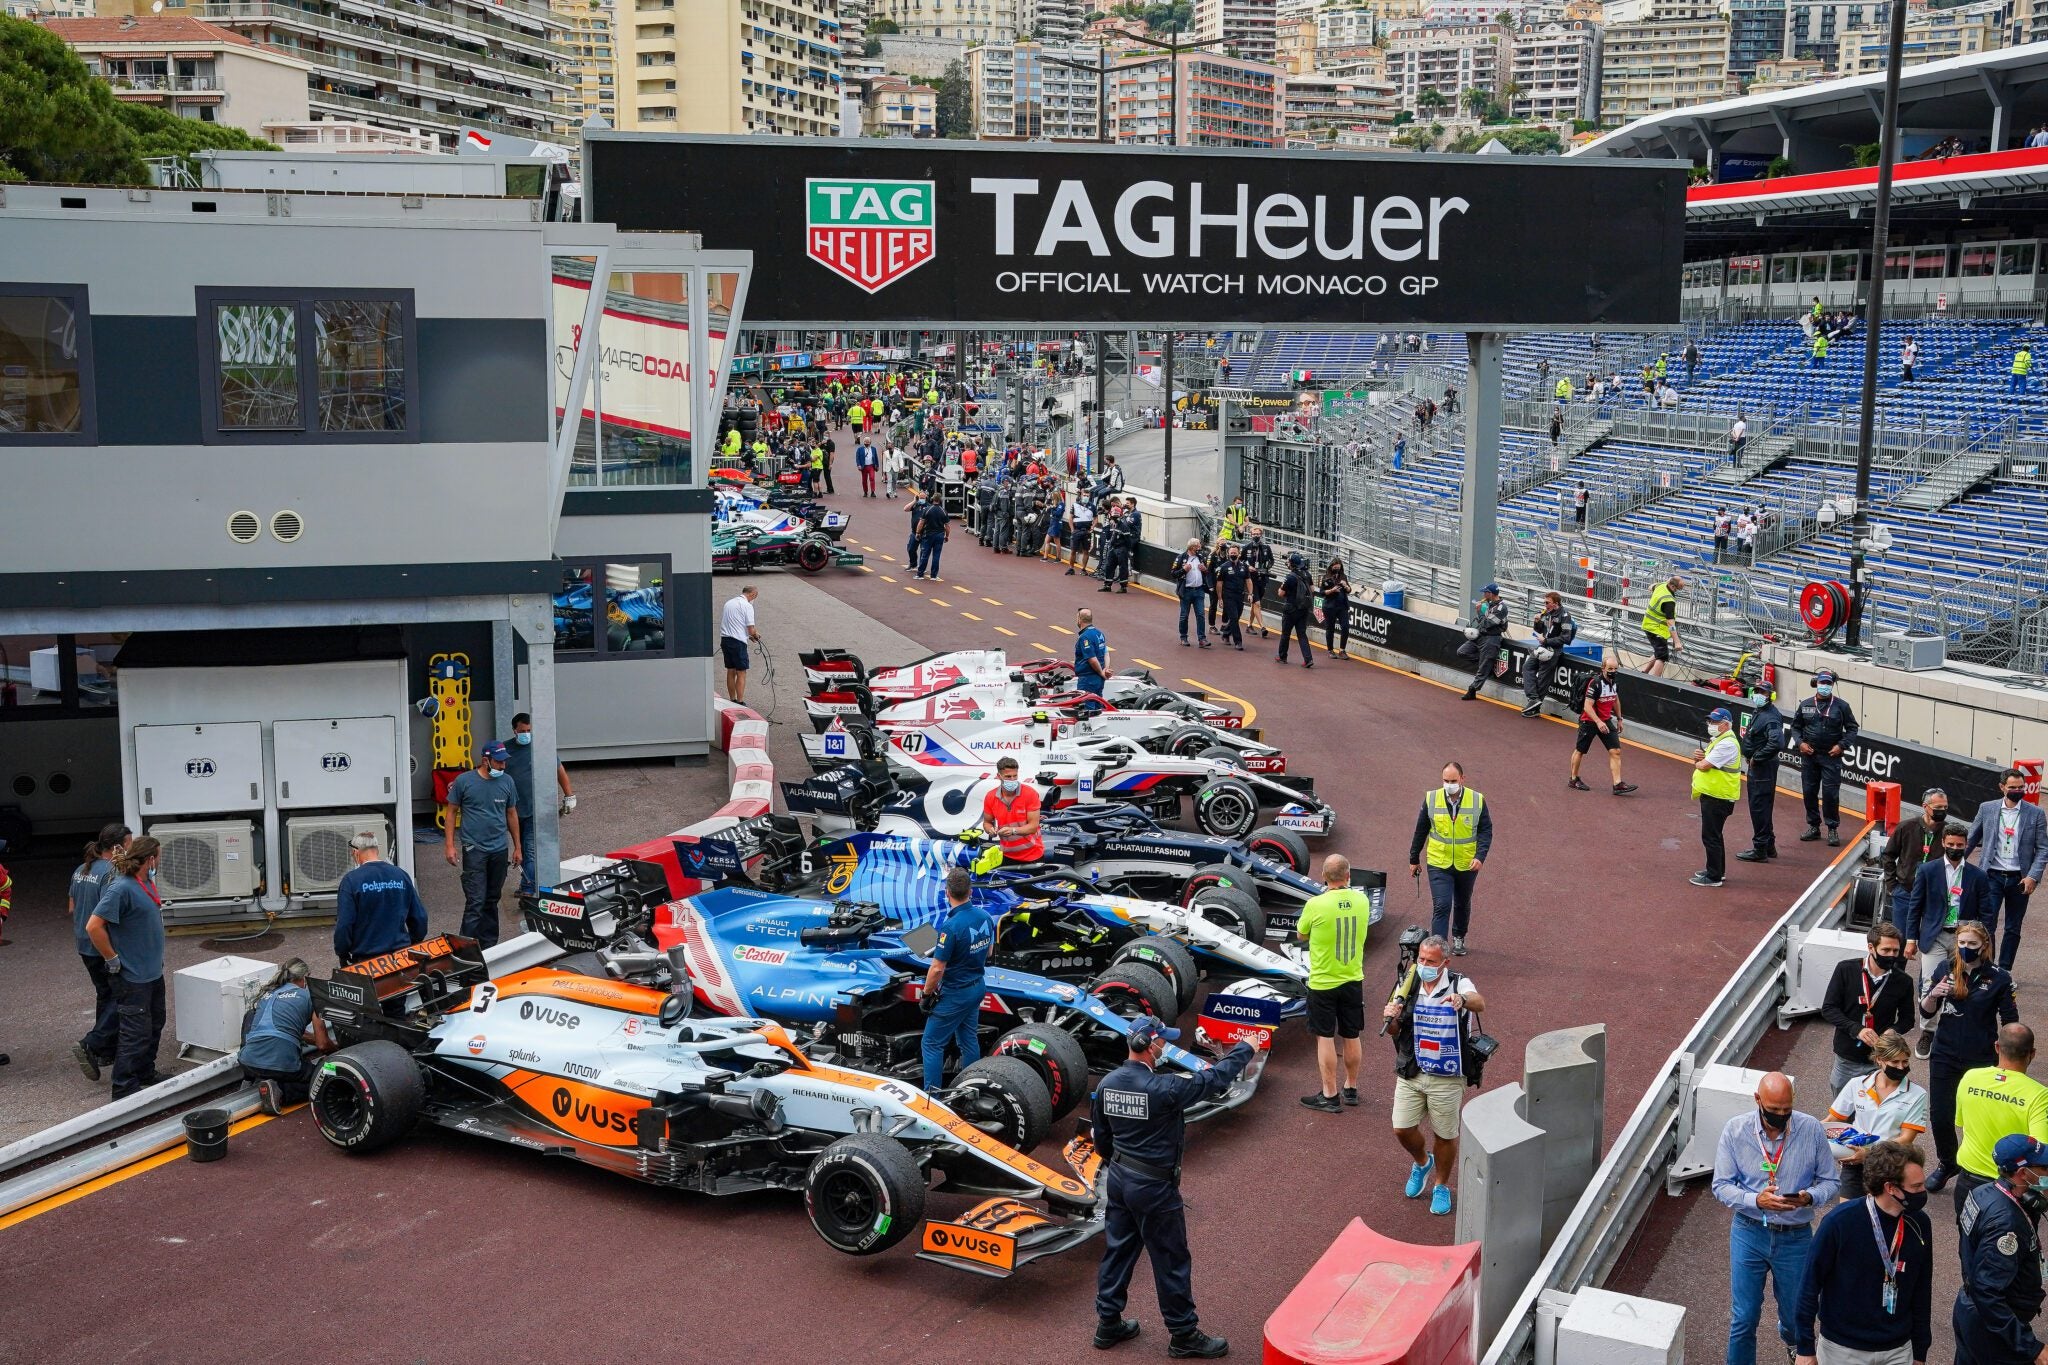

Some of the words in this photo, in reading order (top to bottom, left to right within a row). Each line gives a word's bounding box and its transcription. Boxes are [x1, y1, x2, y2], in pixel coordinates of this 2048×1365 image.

[816, 185, 925, 223] TAG
[813, 228, 929, 285] HEUER
[995, 271, 1131, 294] OFFICIAL
[1142, 272, 1245, 295] WATCH
[1257, 274, 1388, 296] MONACO
[1399, 275, 1440, 297] GP
[790, 516, 797, 526] 9
[712, 547, 732, 555] zant
[826, 737, 844, 750] 1&1
[902, 733, 923, 752] 47
[970, 741, 1021, 750] URALKALI
[1246, 760, 1265, 768] RLEN
[1778, 751, 1802, 765] OFFICI
[789, 787, 838, 801] ALPHATAURI
[896, 790, 916, 808] 22
[1277, 816, 1324, 830] URALKALI
[708, 855, 736, 865] VERSA
[800, 851, 813, 874] 6
[548, 901, 583, 917] Castrol
[667, 901, 692, 928] 14
[755, 917, 790, 927] RENAULT
[746, 924, 798, 938] E-TECH
[745, 947, 786, 964] Castrol
[331, 985, 361, 1002] Hilton
[473, 985, 497, 1013] 3
[751, 985, 846, 1010] ALPINE
[1213, 1001, 1261, 1019] Acronis
[1047, 1059, 1062, 1107] ZERO
[792, 1088, 830, 1100] RICHARD
[831, 1092, 857, 1105] MILLE
[1105, 1091, 1147, 1106] SECURITE
[1967, 1086, 2026, 1107] PETRONAS
[1003, 1092, 1025, 1140] ZERO
[1106, 1103, 1146, 1117] PIT-LANE
[808, 1153, 847, 1182] ZERO
